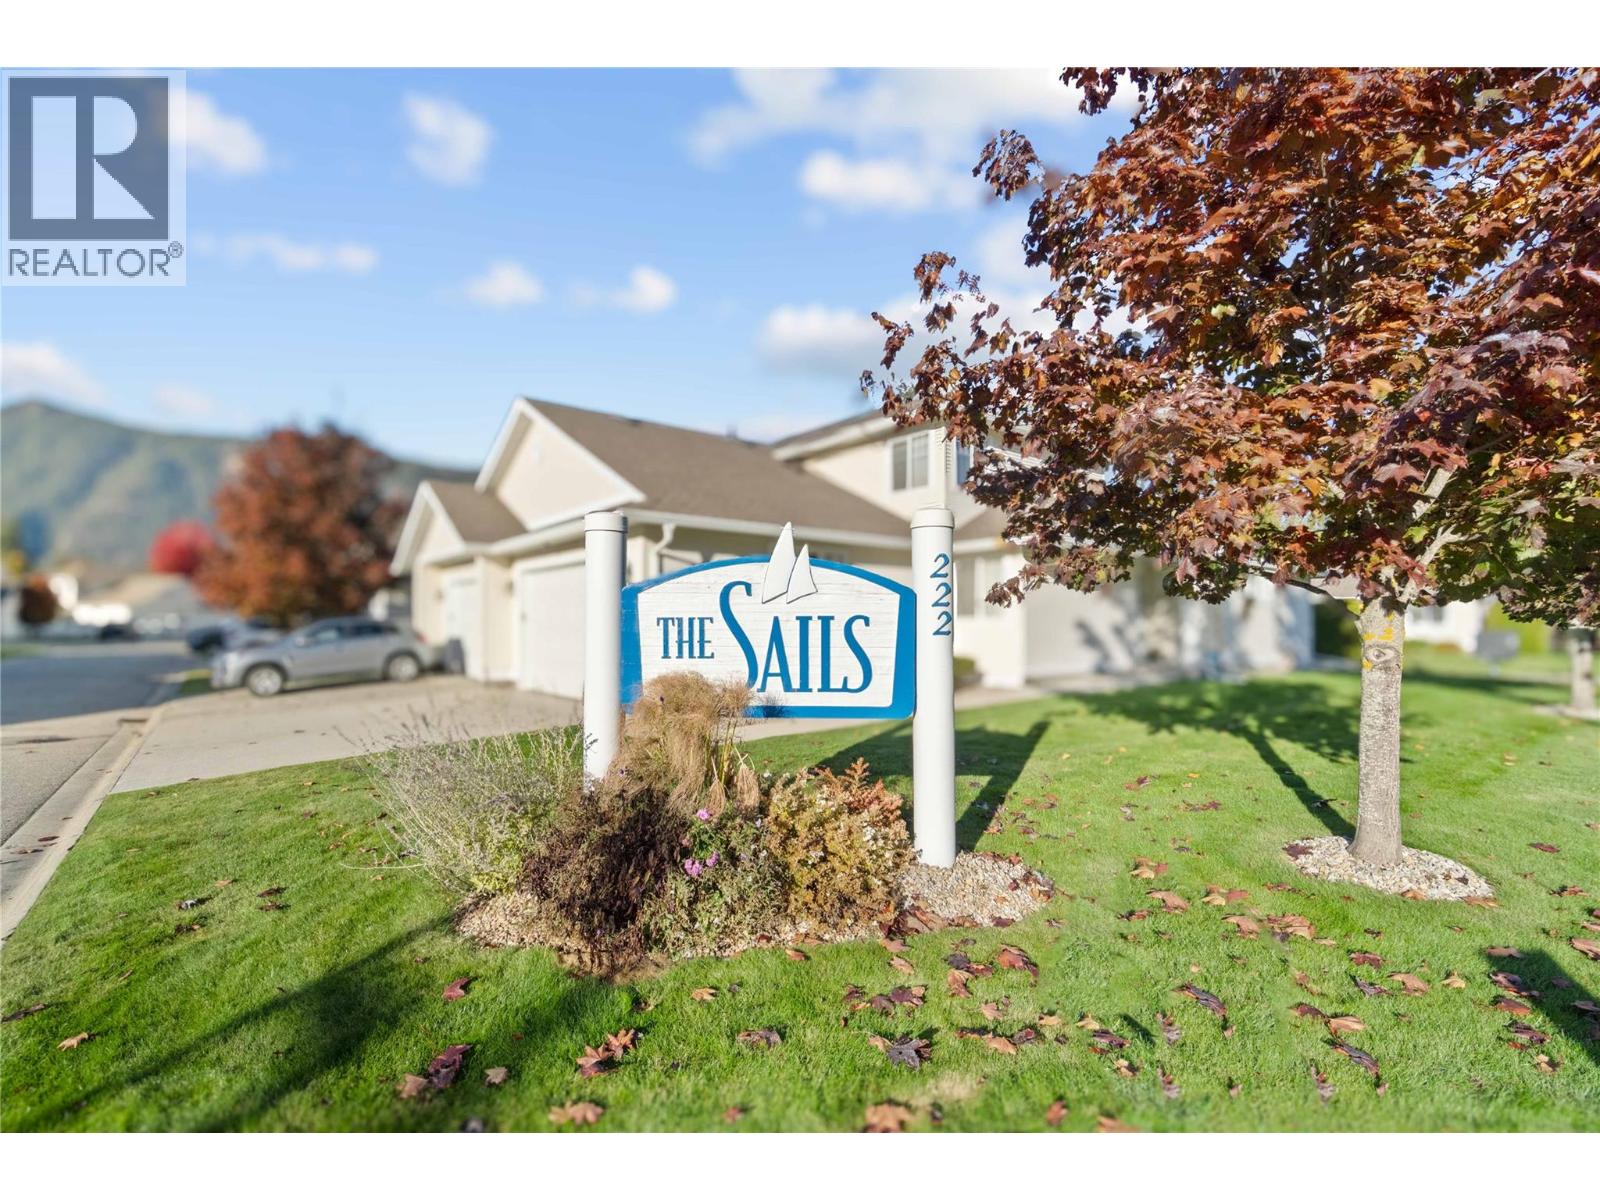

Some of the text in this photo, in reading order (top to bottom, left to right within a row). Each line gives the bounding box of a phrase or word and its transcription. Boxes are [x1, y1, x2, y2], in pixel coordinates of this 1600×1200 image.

[657, 581, 872, 693] THE SAILS
[930, 554, 953, 635] 222
